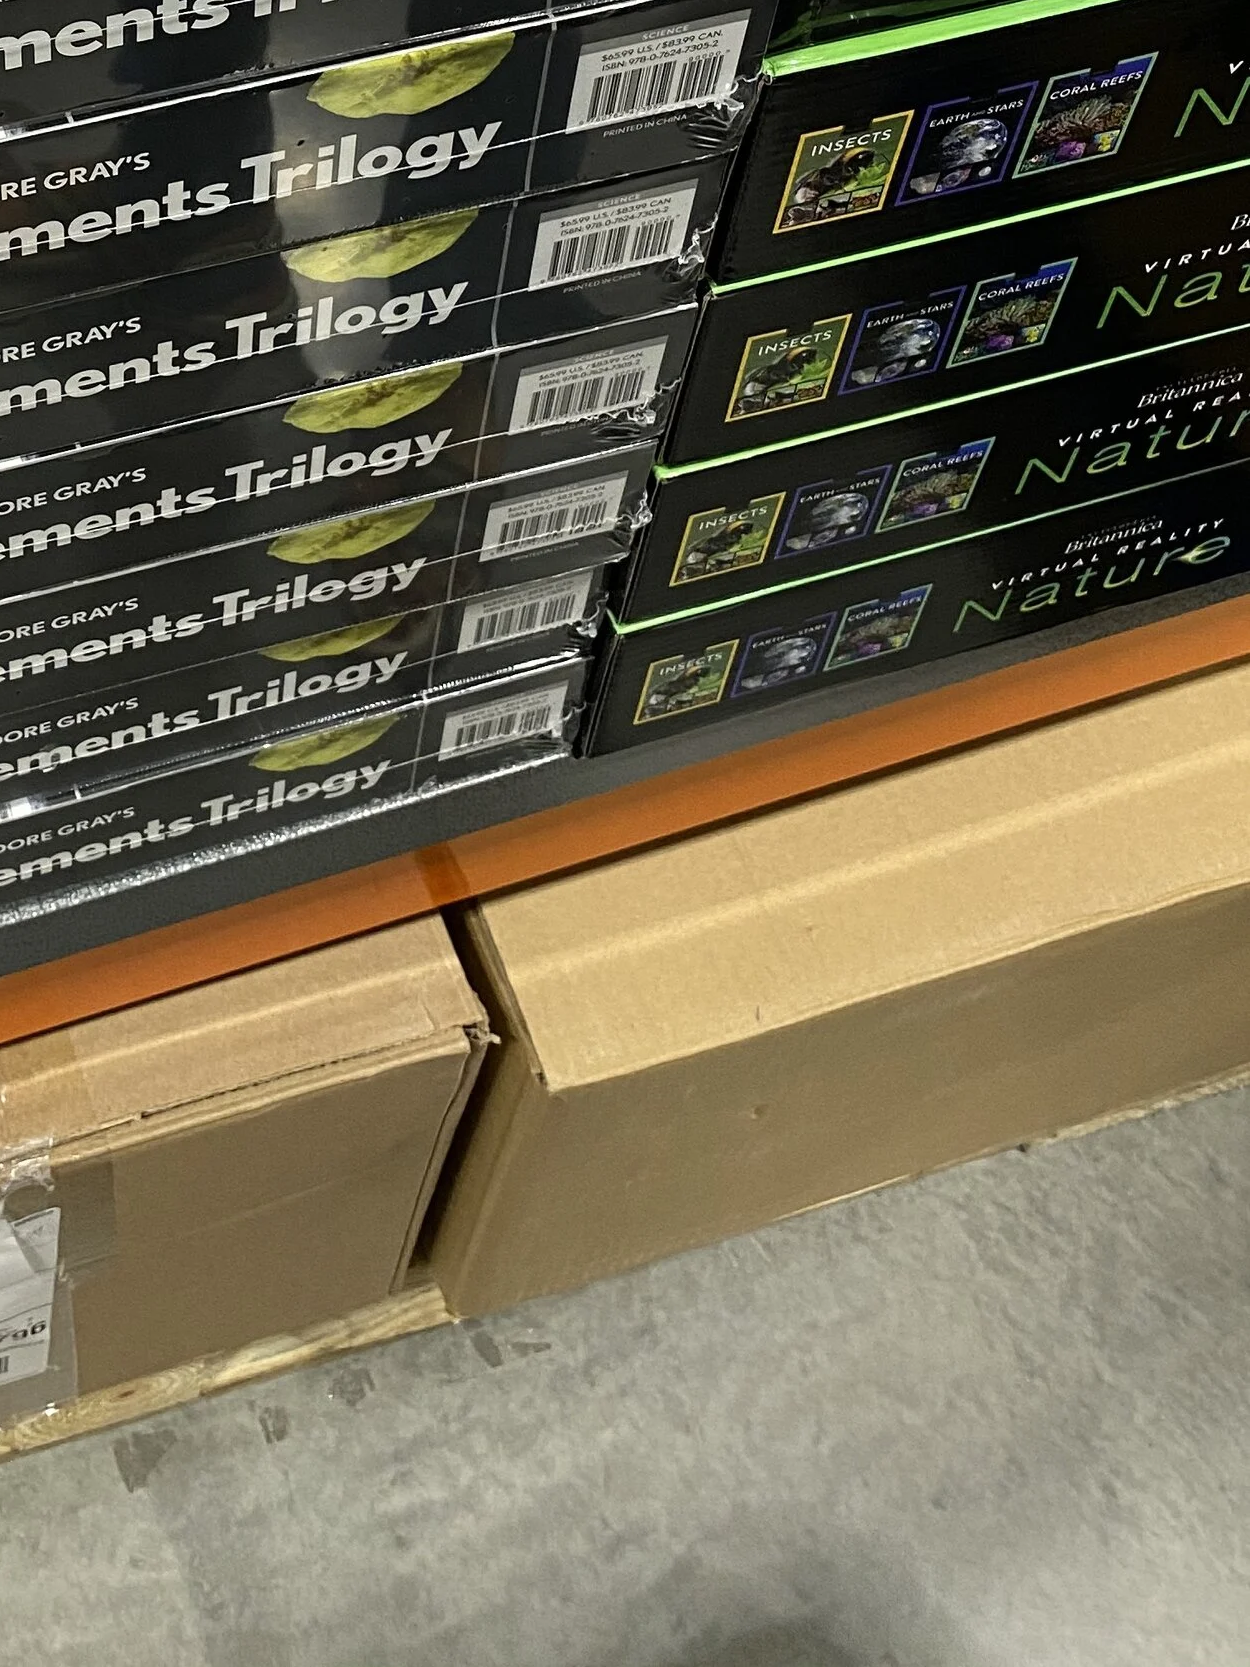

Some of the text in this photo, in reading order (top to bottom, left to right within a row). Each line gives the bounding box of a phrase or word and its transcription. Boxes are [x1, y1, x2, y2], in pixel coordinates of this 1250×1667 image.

[952, 536, 1231, 633] Nature
[991, 518, 1224, 590] VIRTUAL REALITY
[659, 651, 723, 675] INSECTS
[200, 760, 392, 821] Trilogy
[57, 806, 136, 838] GRAY'S
